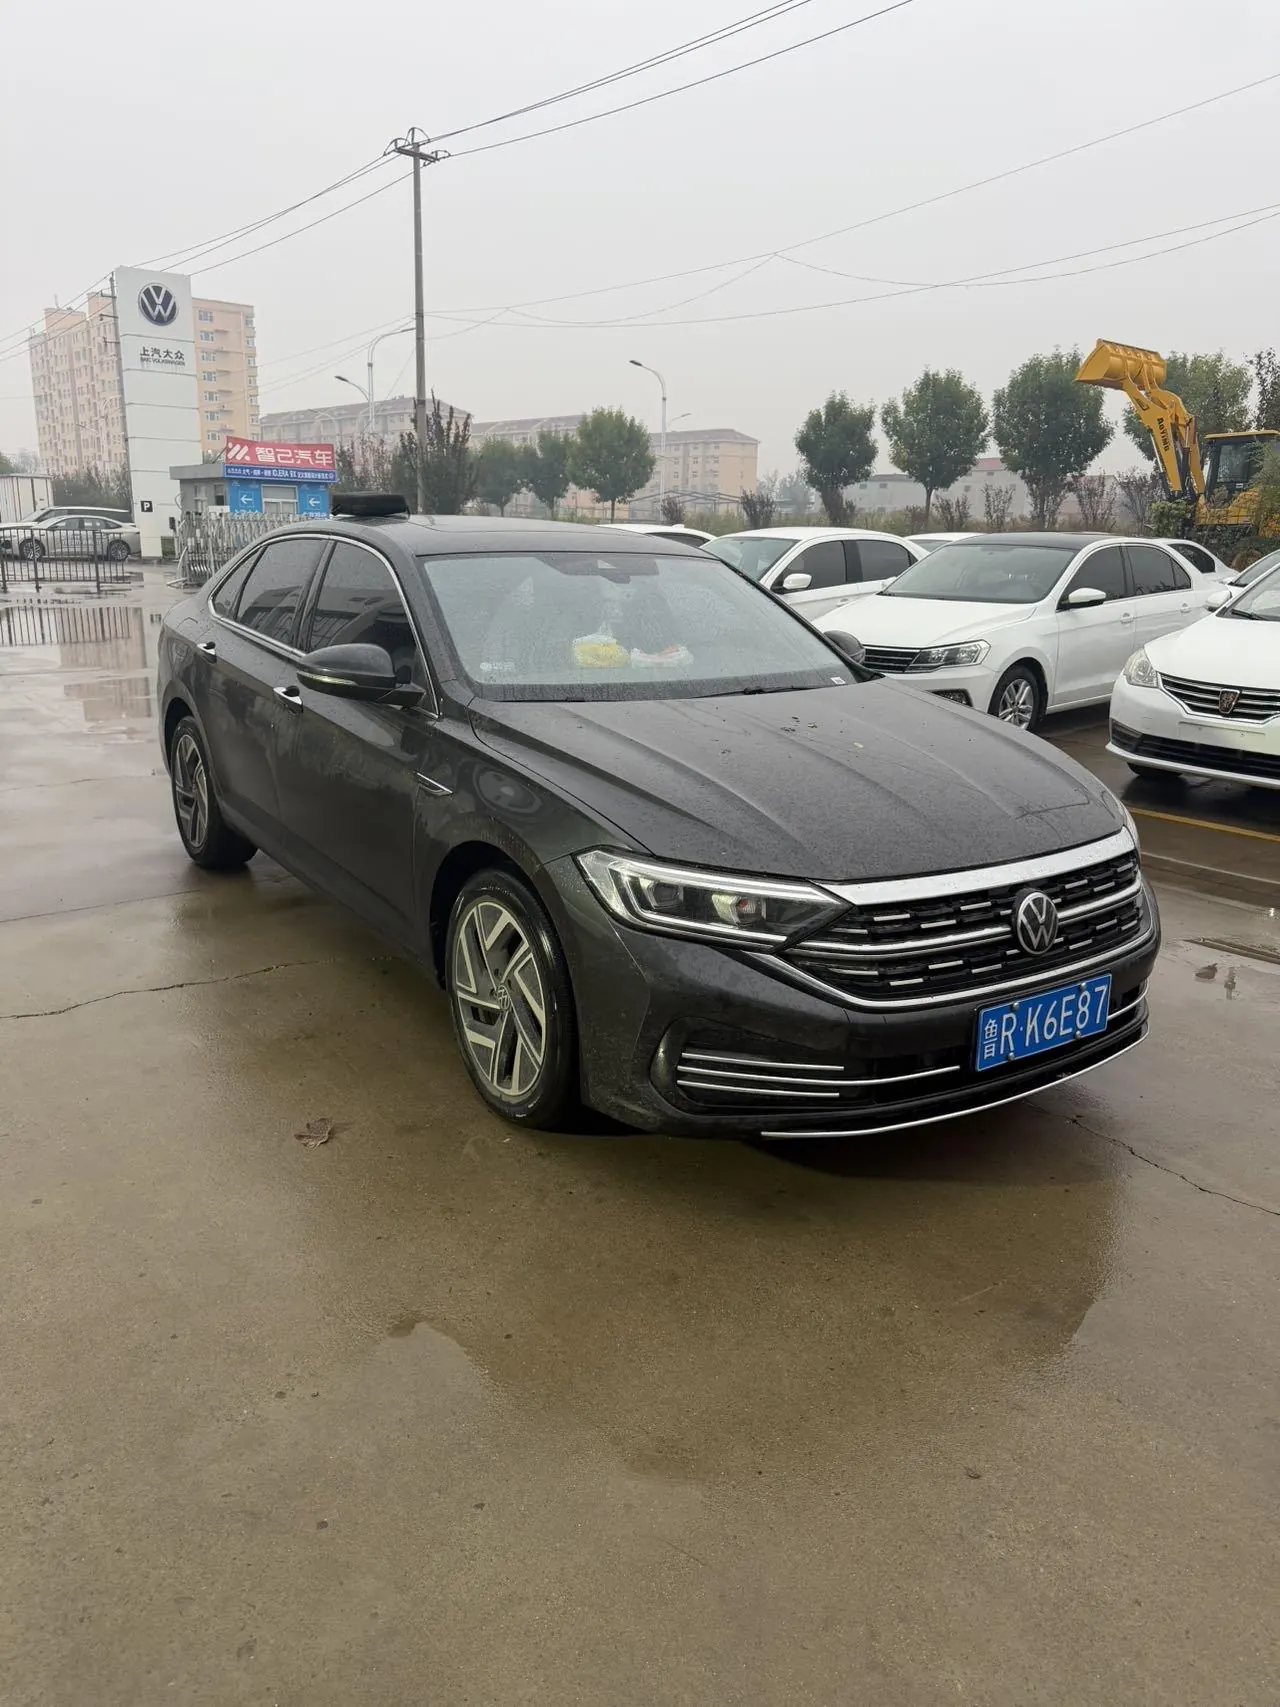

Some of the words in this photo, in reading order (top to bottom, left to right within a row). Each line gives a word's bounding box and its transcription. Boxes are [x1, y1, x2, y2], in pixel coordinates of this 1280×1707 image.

[140, 346, 184, 360] 上汽大众
[255, 446, 333, 466] 智己汽车
[143, 502, 151, 511] P
